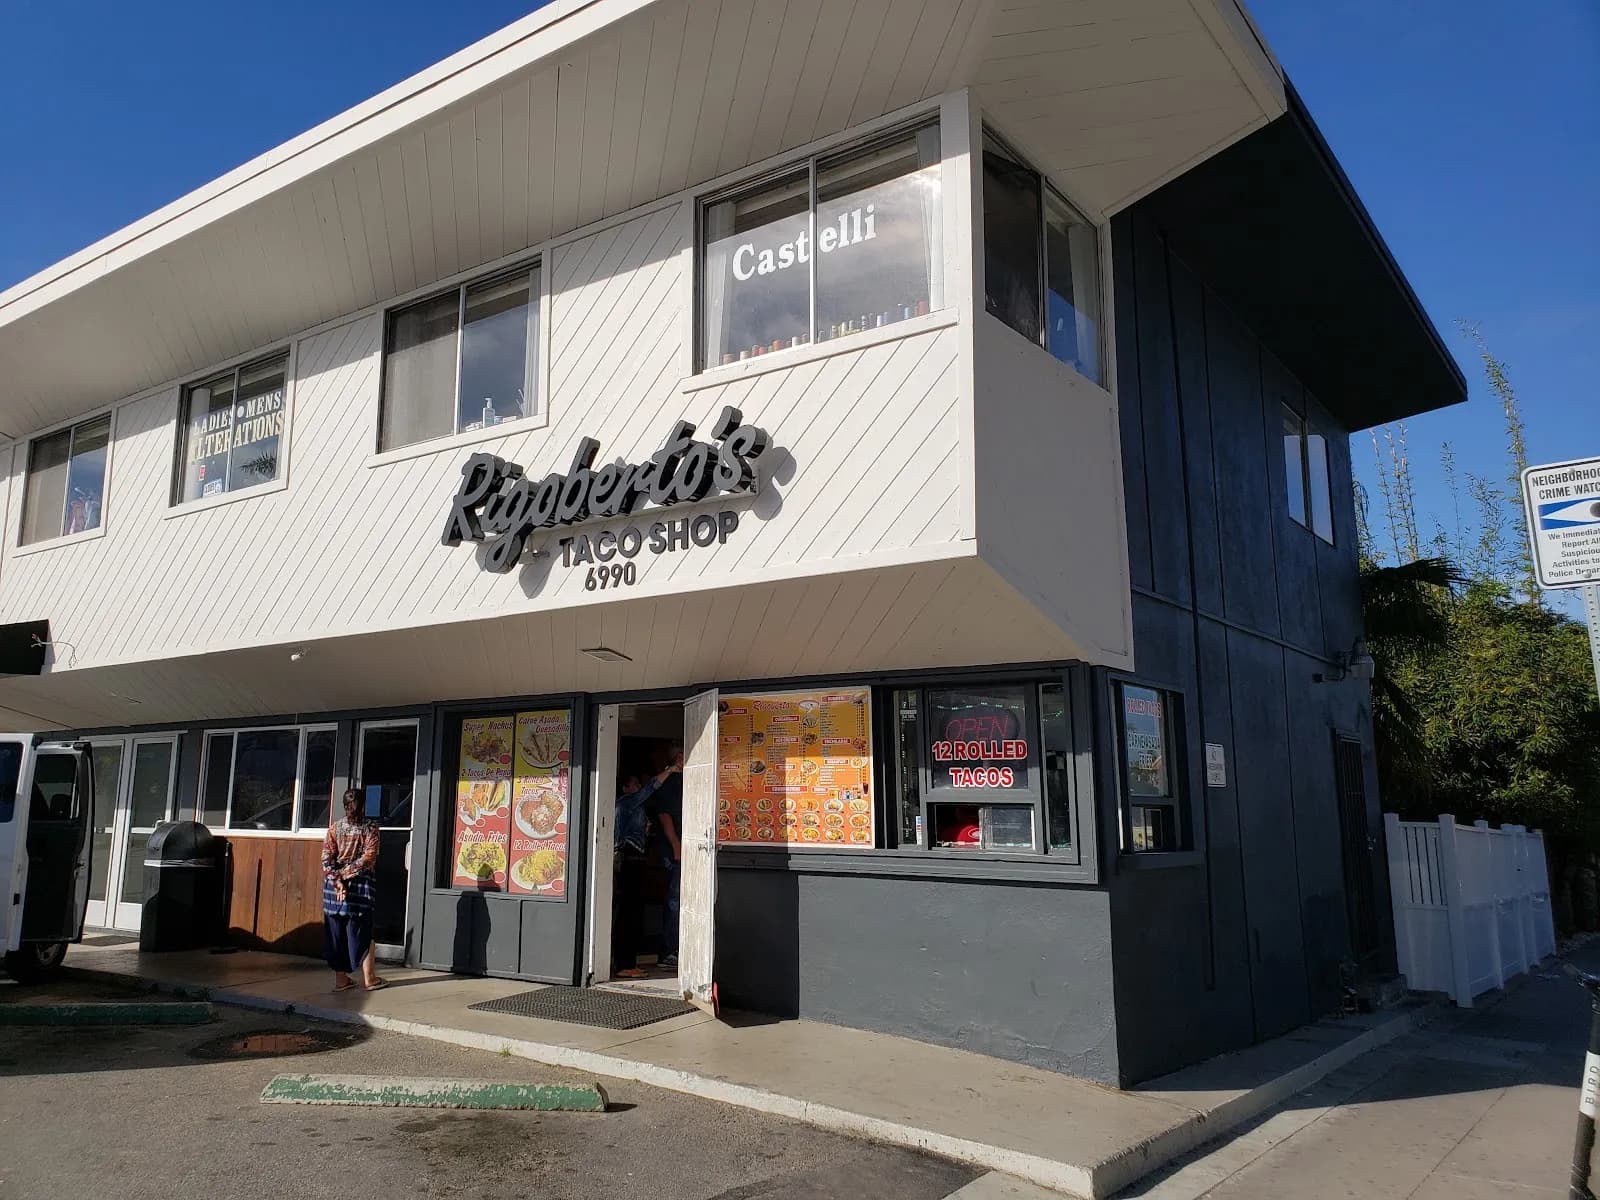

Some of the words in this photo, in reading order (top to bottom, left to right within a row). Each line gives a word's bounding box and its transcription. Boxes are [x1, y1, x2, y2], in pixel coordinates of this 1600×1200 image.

[732, 204, 877, 281] Castelli
[246, 391, 282, 418] MENS
[441, 405, 767, 574] Rigoberto's
[1539, 486, 1571, 500] CRIME
[559, 526, 643, 567] TACO
[649, 511, 739, 554] SHOP
[1561, 539, 1590, 548] Report
[1552, 559, 1590, 568] Activities
[584, 562, 637, 591] 6990
[538, 714, 560, 724] Asada
[945, 715, 1009, 741] OPEN
[932, 741, 953, 760] 12
[954, 740, 1027, 760] ROLLED
[949, 767, 1013, 787] TACOS
[487, 831, 508, 843] Fries
[1585, 1065, 1600, 1104] BIRD
